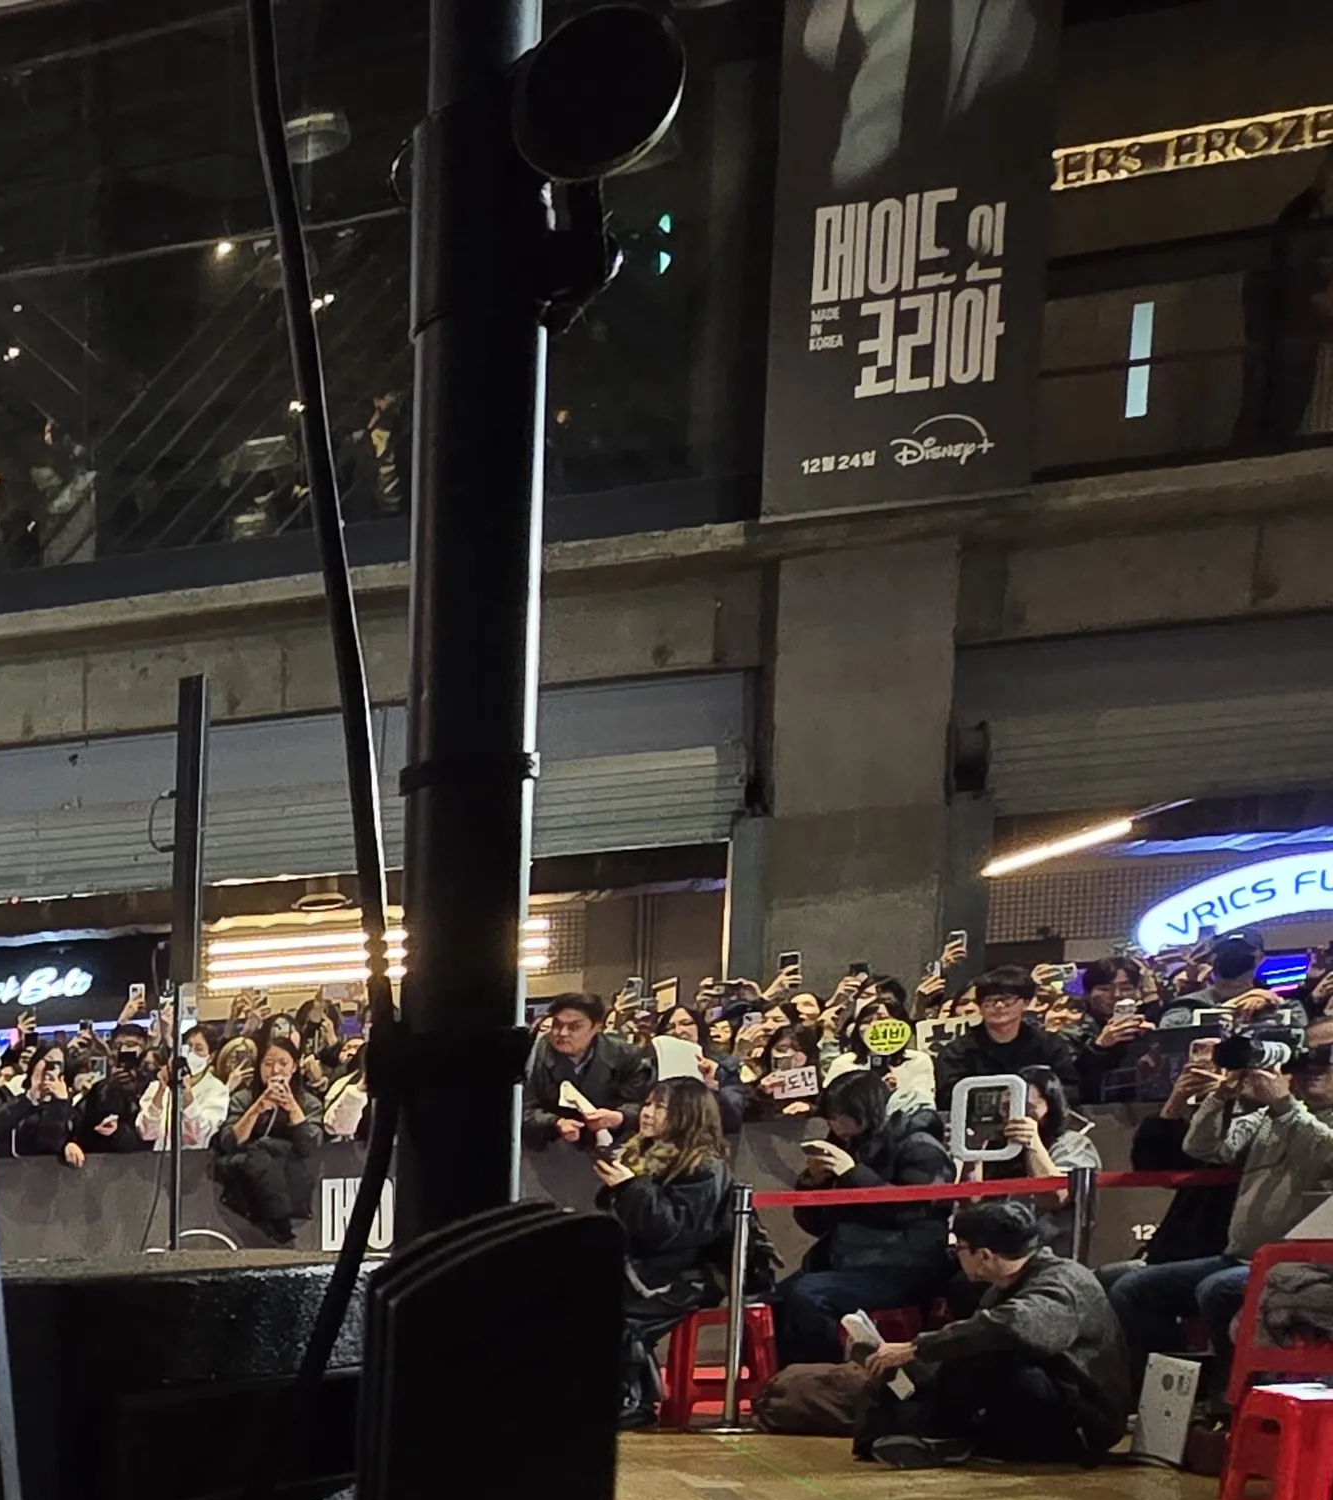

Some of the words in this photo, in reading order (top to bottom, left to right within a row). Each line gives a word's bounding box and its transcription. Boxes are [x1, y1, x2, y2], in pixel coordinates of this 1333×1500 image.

[811, 188, 958, 304] 메이드
[810, 307, 841, 322] MADE
[810, 323, 823, 337] IN
[809, 334, 845, 352] KOREA
[854, 284, 1006, 399] 코리아
[801, 456, 835, 474] 12월
[837, 451, 876, 470] 24일
[890, 413, 995, 465] Disney+
[1166, 878, 1277, 935] VRICS
[15, 965, 94, 1006] Belt
[1132, 1223, 1160, 1241] 12
